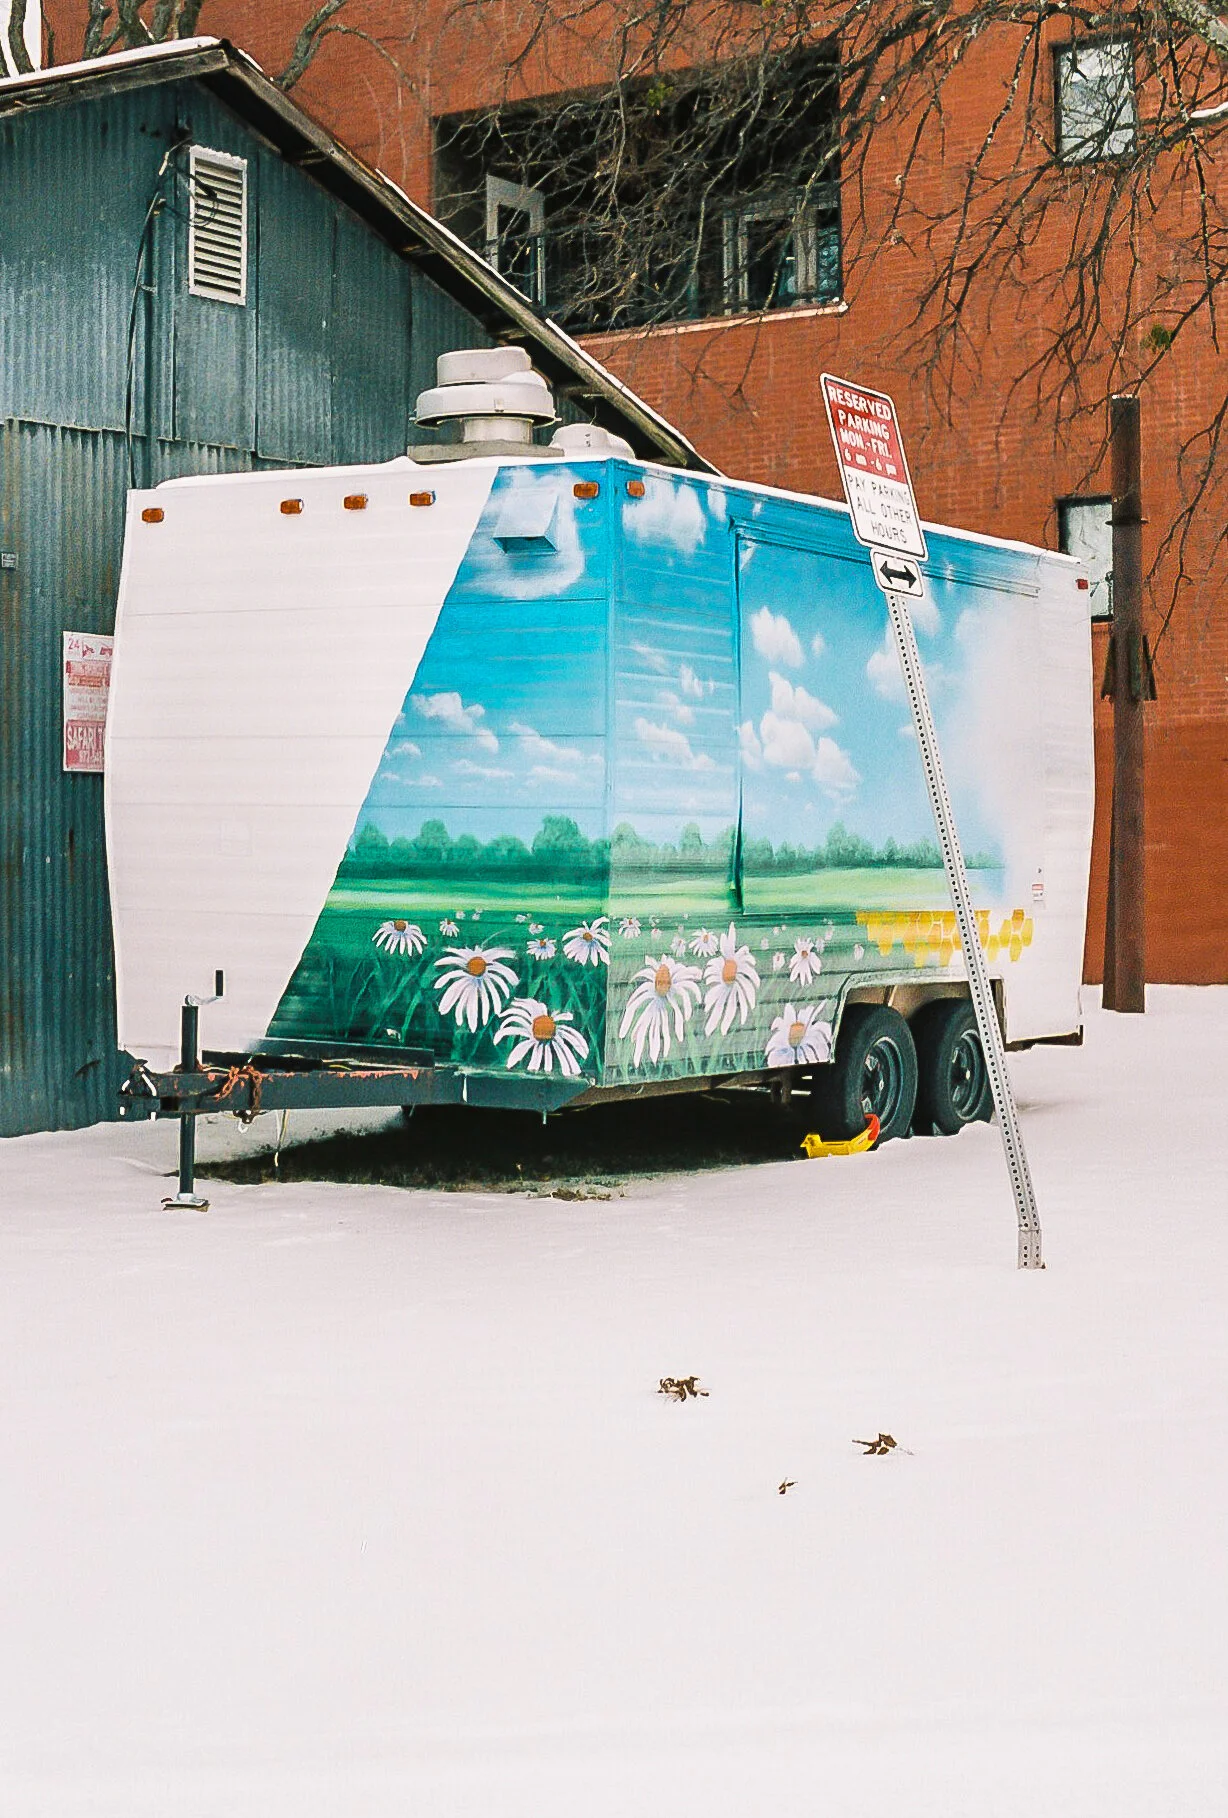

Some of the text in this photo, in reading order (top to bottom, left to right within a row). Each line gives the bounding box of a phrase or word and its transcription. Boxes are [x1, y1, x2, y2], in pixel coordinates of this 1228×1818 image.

[827, 386, 892, 420] RESERVED
[837, 409, 890, 440] PARKING
[844, 448, 852, 462] 6
[848, 473, 911, 506] PAY PARKING
[857, 496, 913, 525] ALL OTHER
[871, 520, 908, 544] HOURS
[68, 637, 80, 650] 24
[67, 726, 96, 750] SAFARI
